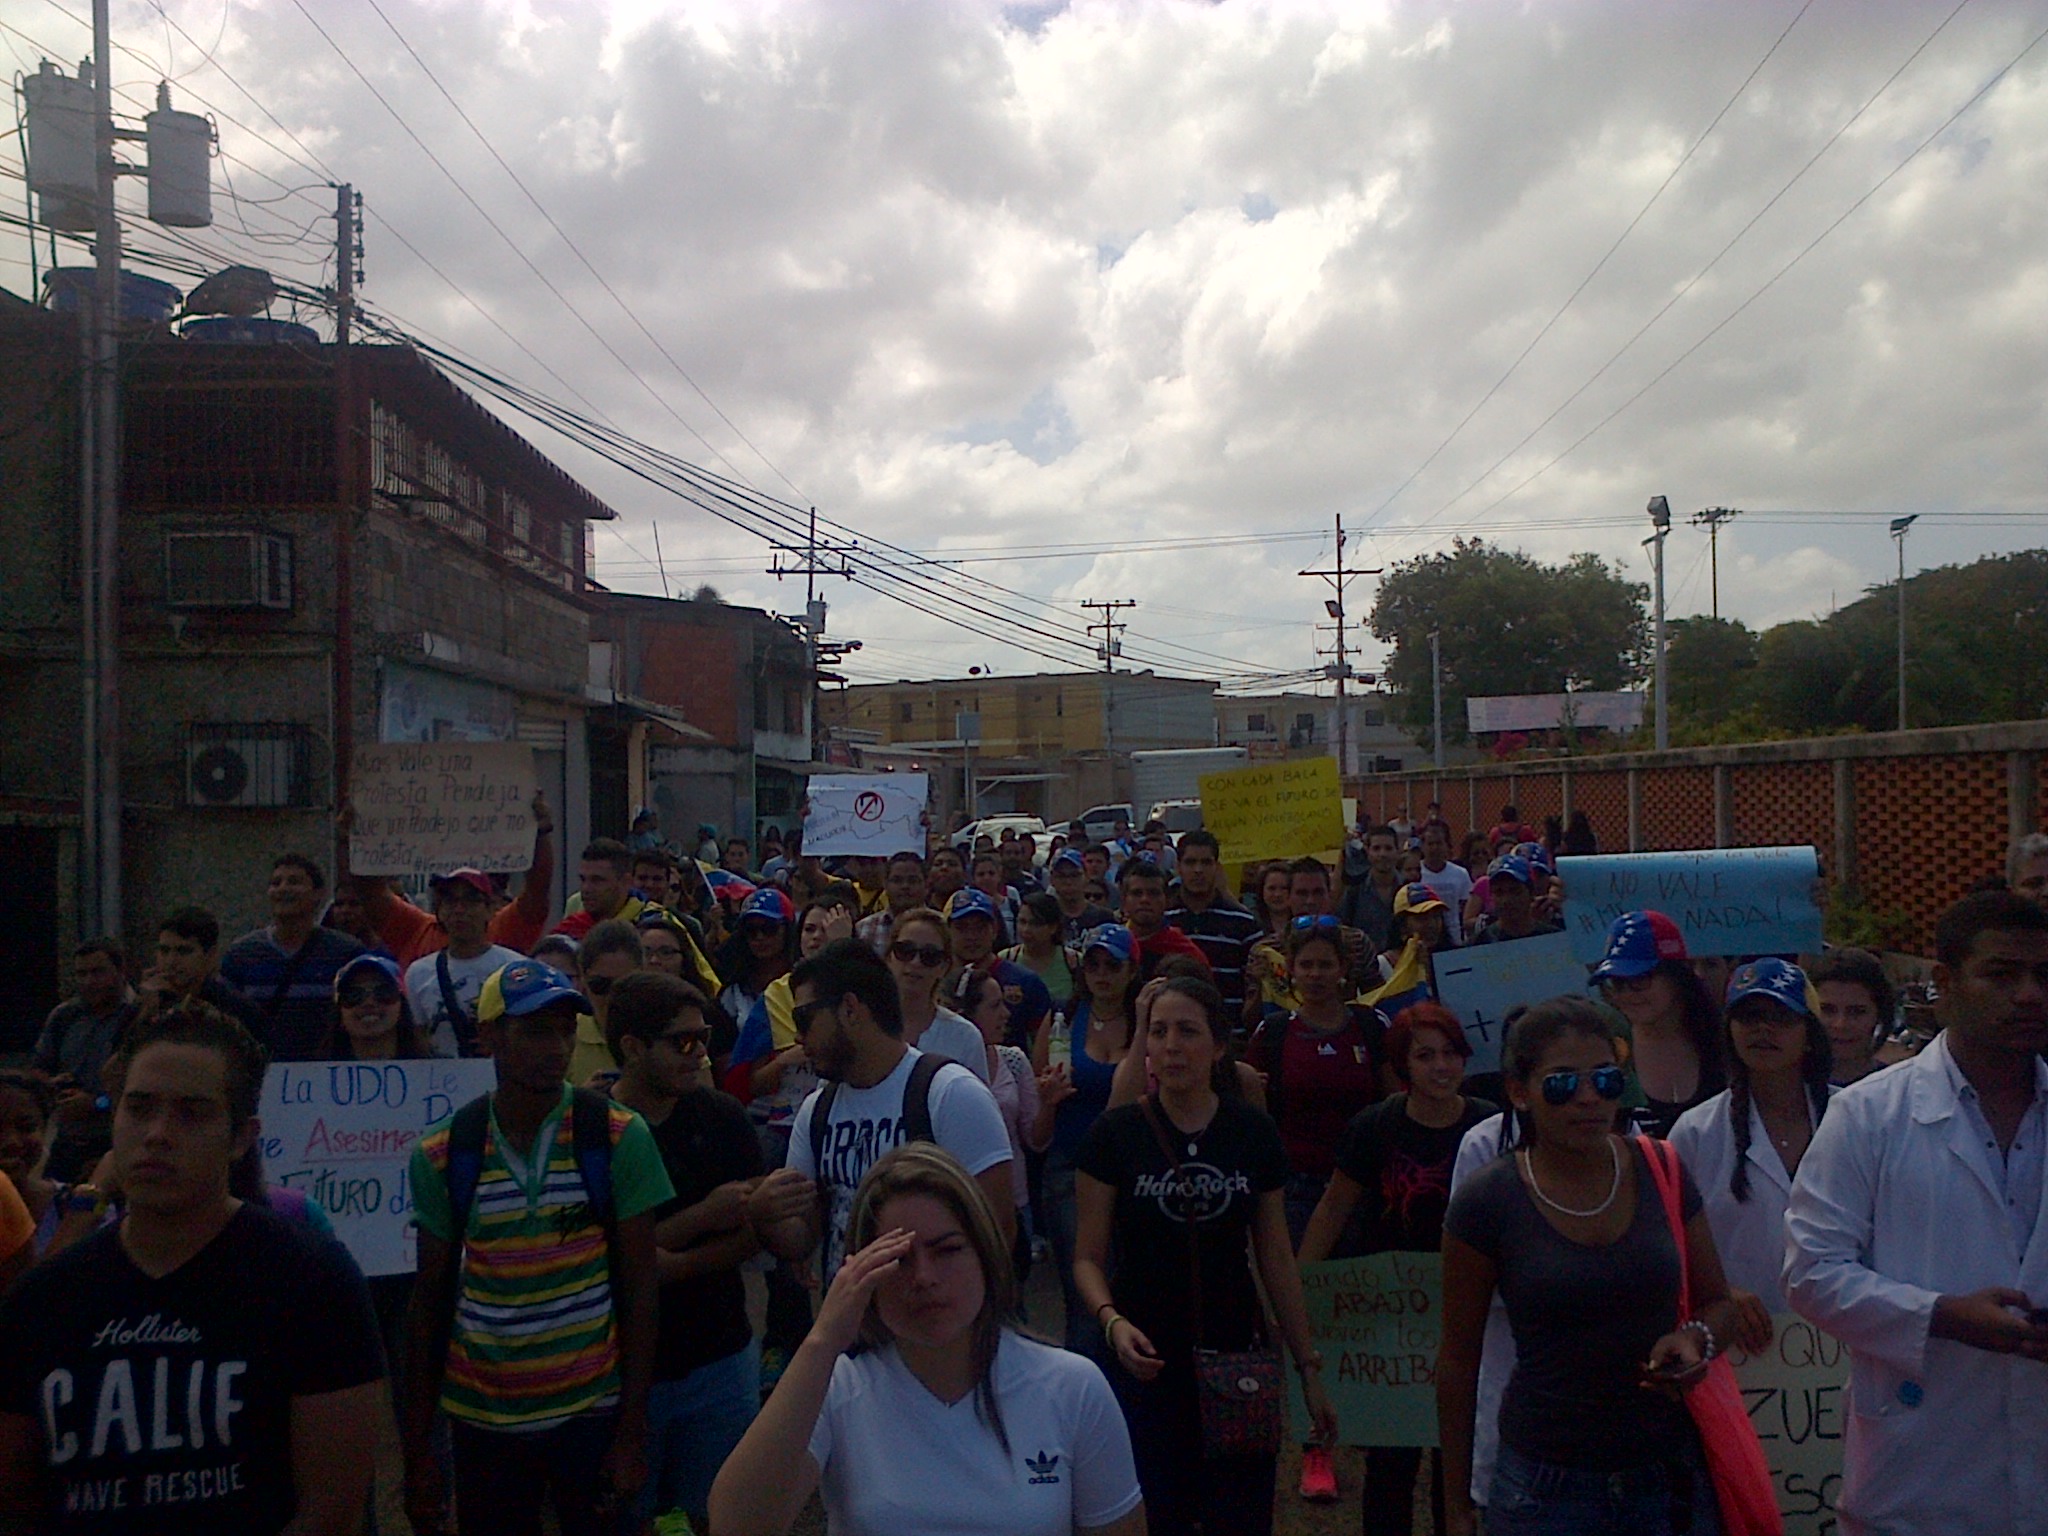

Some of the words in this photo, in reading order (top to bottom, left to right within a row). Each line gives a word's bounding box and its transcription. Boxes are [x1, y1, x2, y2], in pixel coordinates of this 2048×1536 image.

[1206, 778, 1236, 792] CON
[1282, 768, 1318, 783] BALA
[1208, 798, 1228, 812] SE
[1232, 797, 1251, 808] VA
[1255, 795, 1271, 808] EL
[1276, 789, 1319, 804] FUTURO
[1657, 871, 1729, 901] VALE
[281, 1069, 312, 1104] La
[327, 1064, 408, 1109] UDO
[1194, 1169, 1252, 1200] Rock
[1333, 1288, 1430, 1319] ABAJO
[90, 1312, 204, 1349] Hollister
[42, 1355, 248, 1466] CALIF
[142, 1461, 247, 1506] RESCUE
